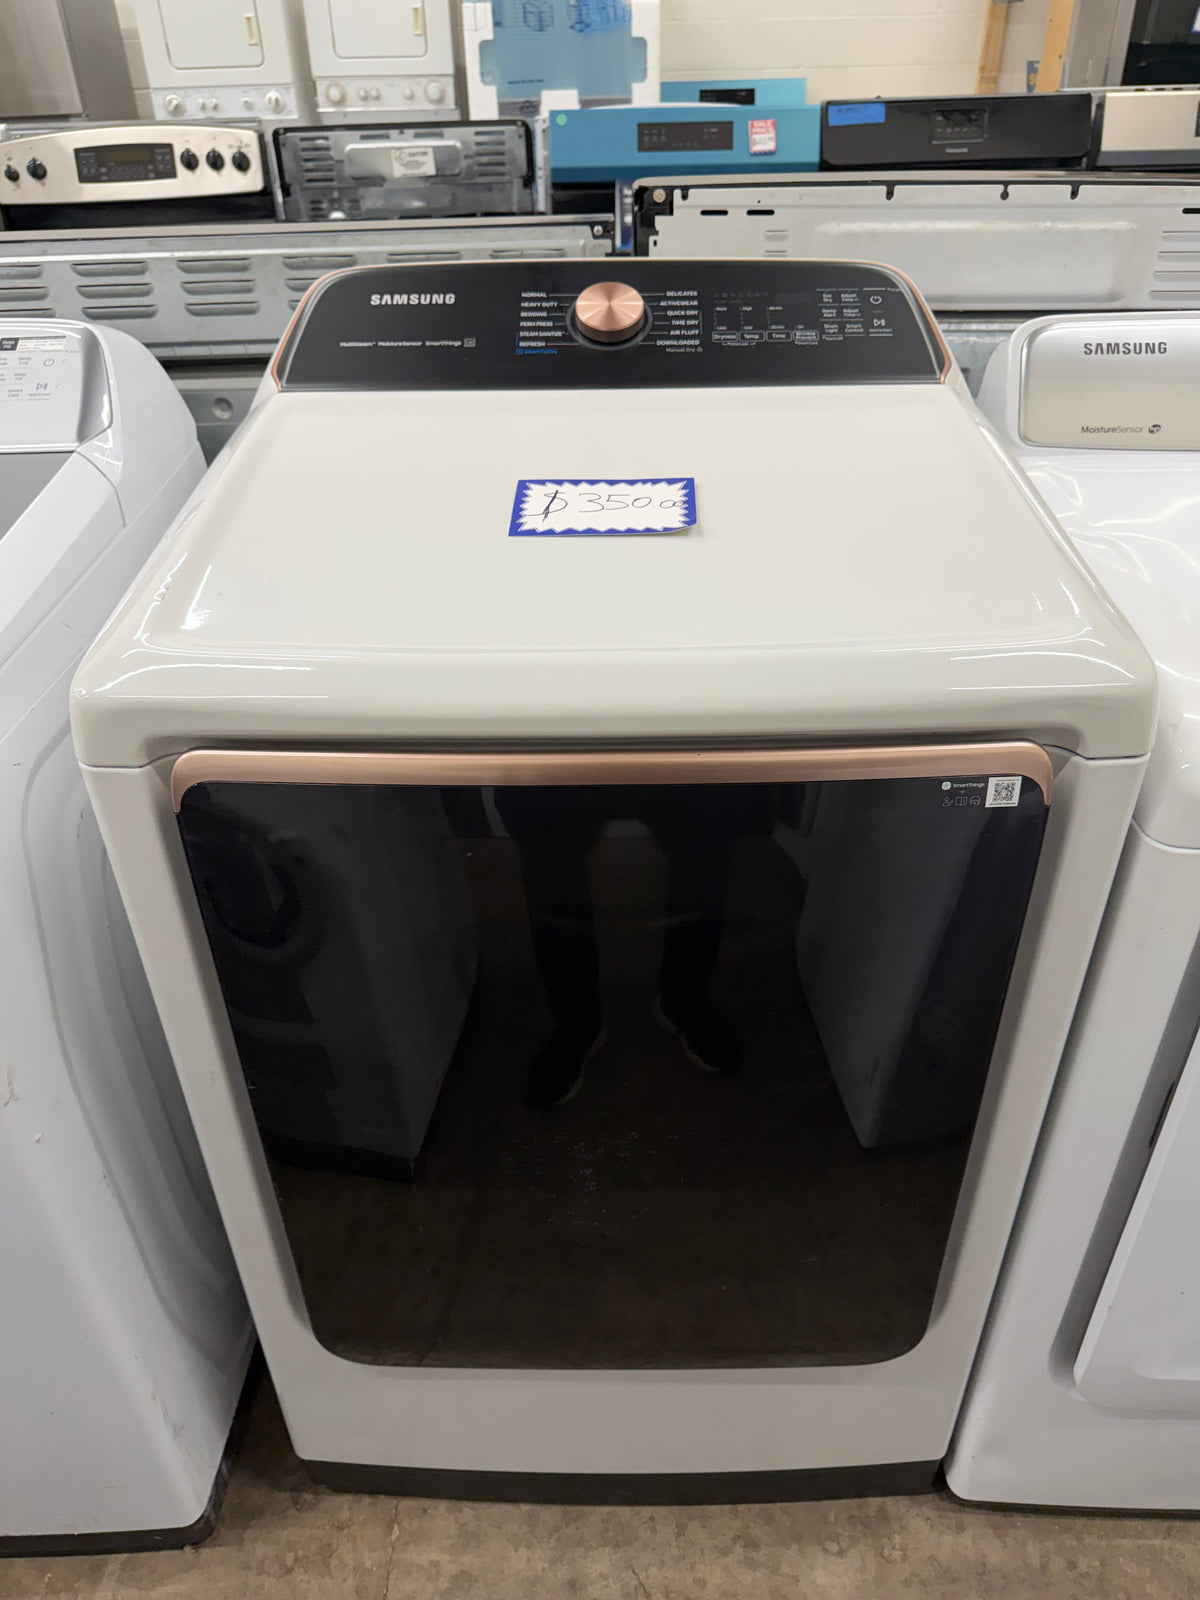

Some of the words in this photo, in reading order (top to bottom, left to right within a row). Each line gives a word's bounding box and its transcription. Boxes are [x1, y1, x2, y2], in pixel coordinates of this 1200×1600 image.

[370, 293, 456, 306] SAMSUNG
[1083, 341, 1168, 355] SAMSUNG
[1081, 426, 1144, 434] MoistureSensor
